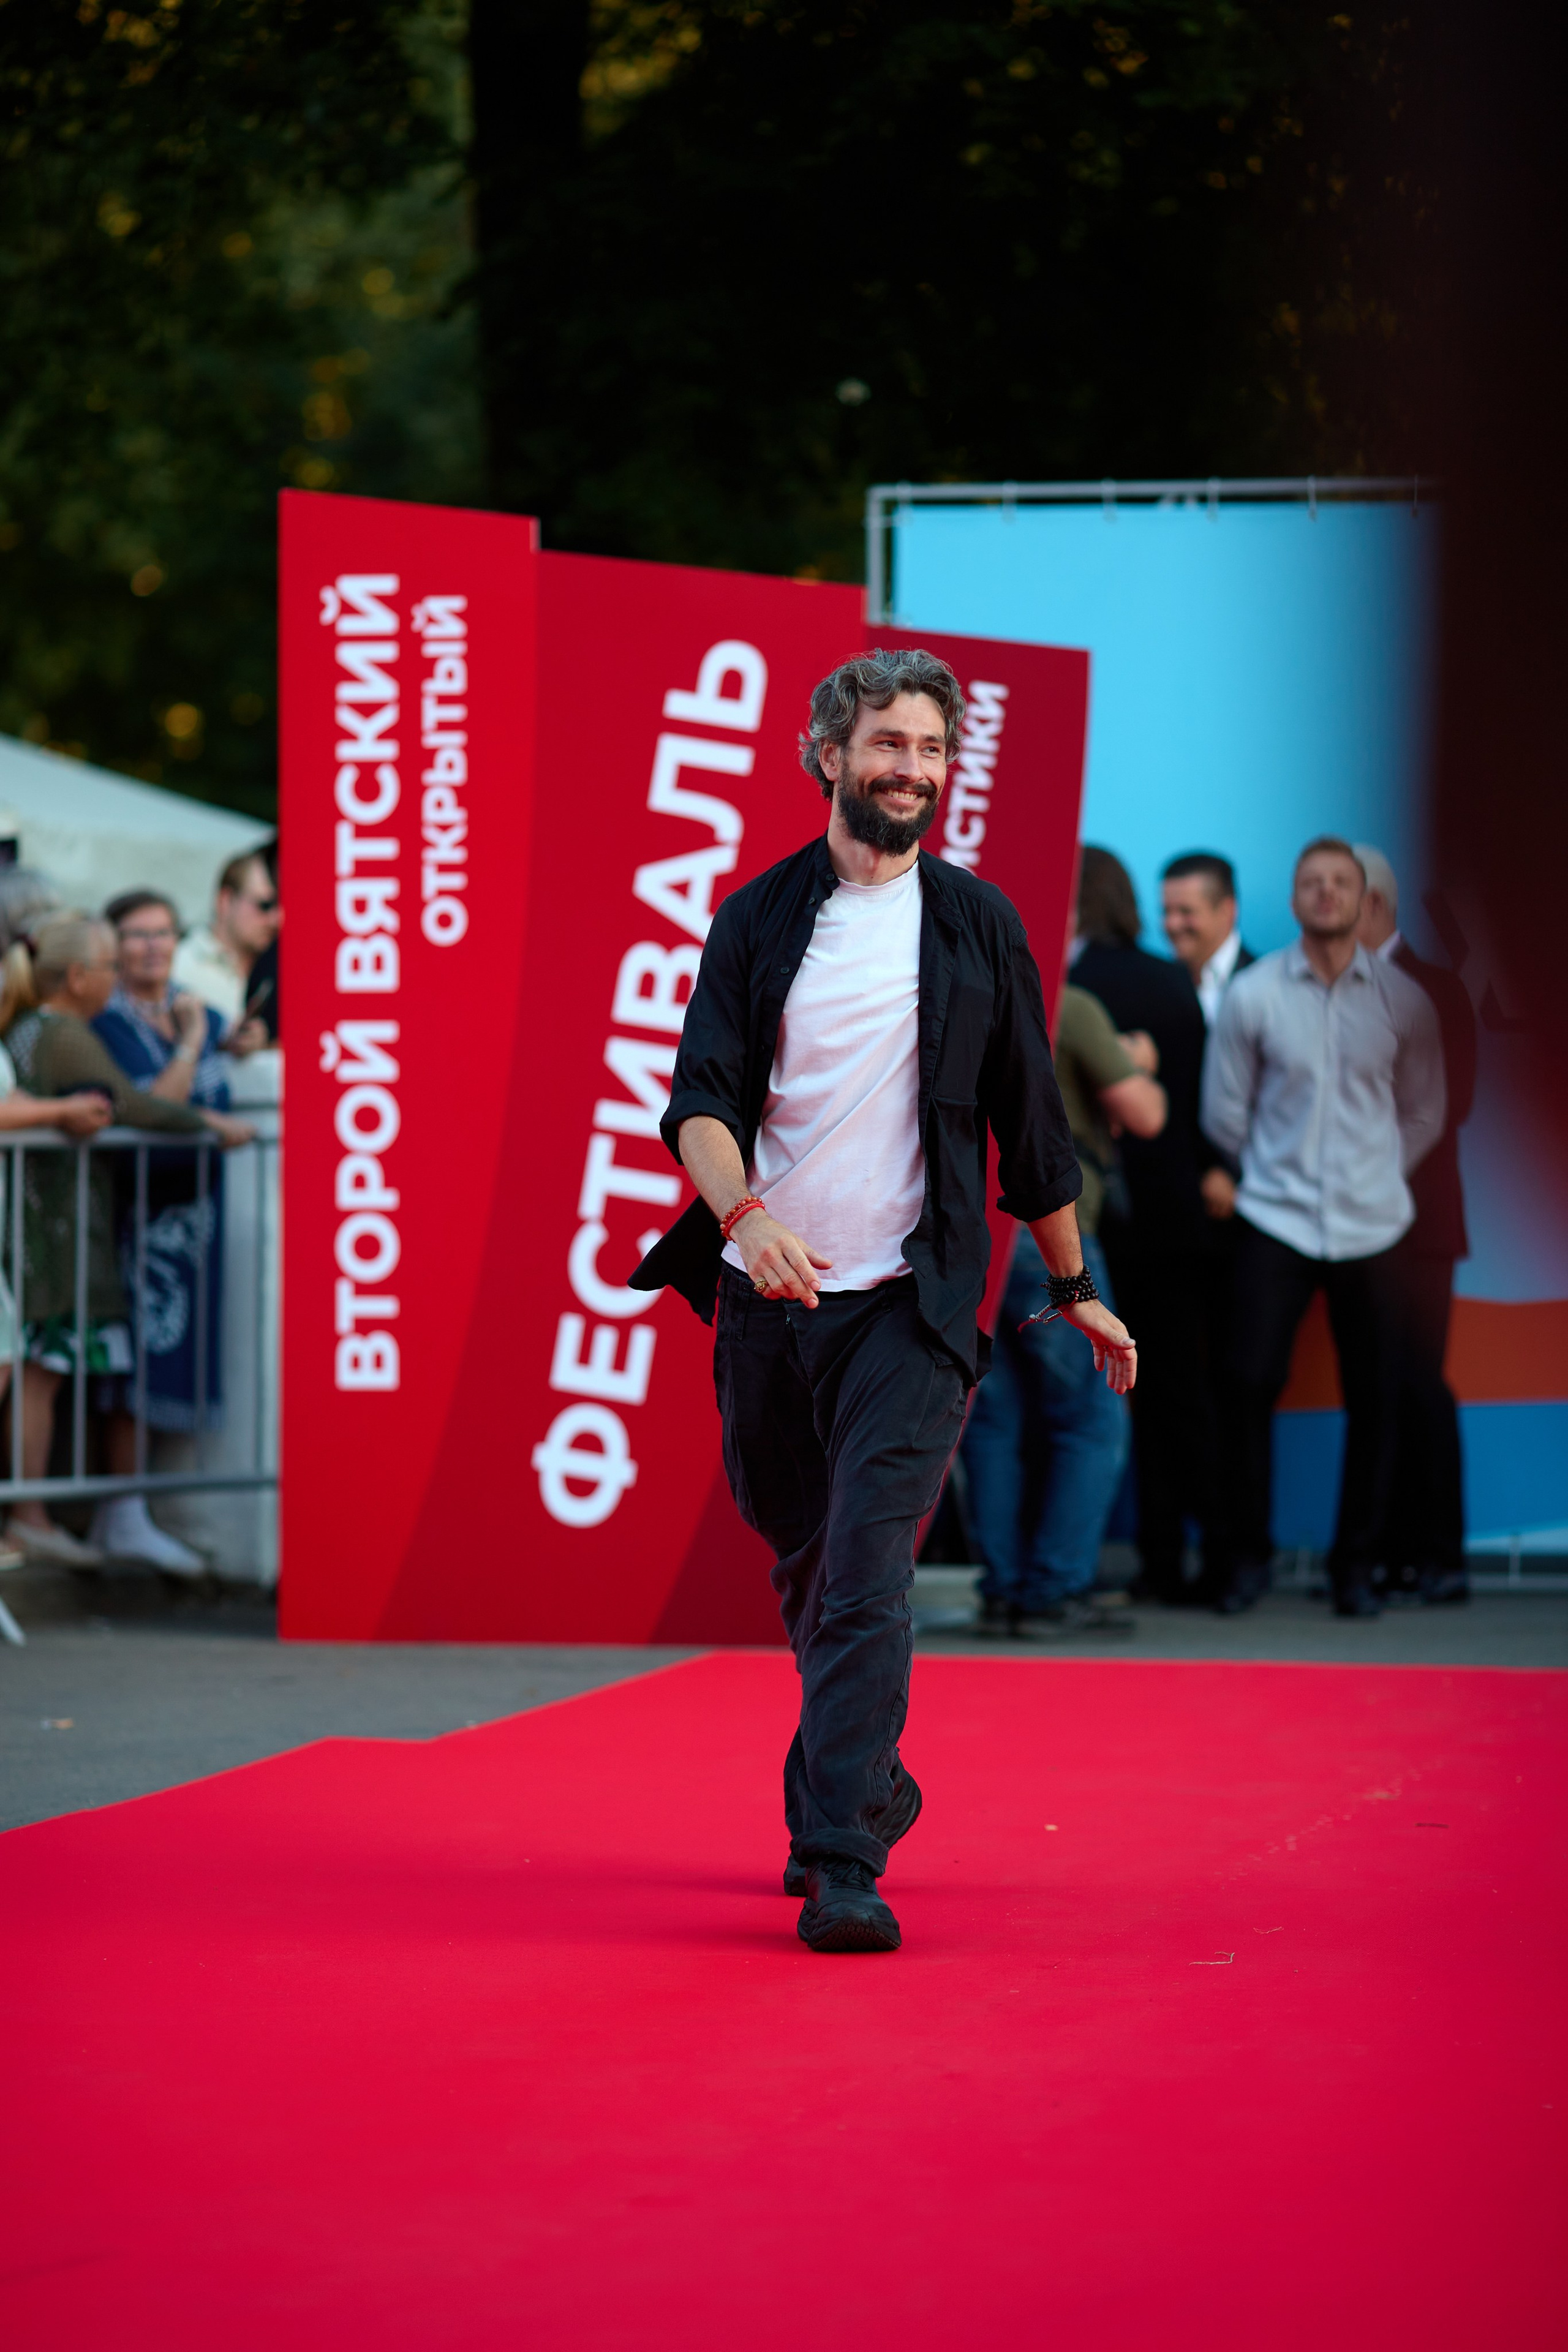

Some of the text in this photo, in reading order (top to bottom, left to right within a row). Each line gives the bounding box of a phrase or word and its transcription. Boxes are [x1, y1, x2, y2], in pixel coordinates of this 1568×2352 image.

[320, 573, 400, 1390] ВТОРОЙ ВЯТСКИЙ
[412, 594, 469, 947] ОТКРЫТЫЙ
[532, 639, 769, 1528] ФЕСТИВАЛЬ
